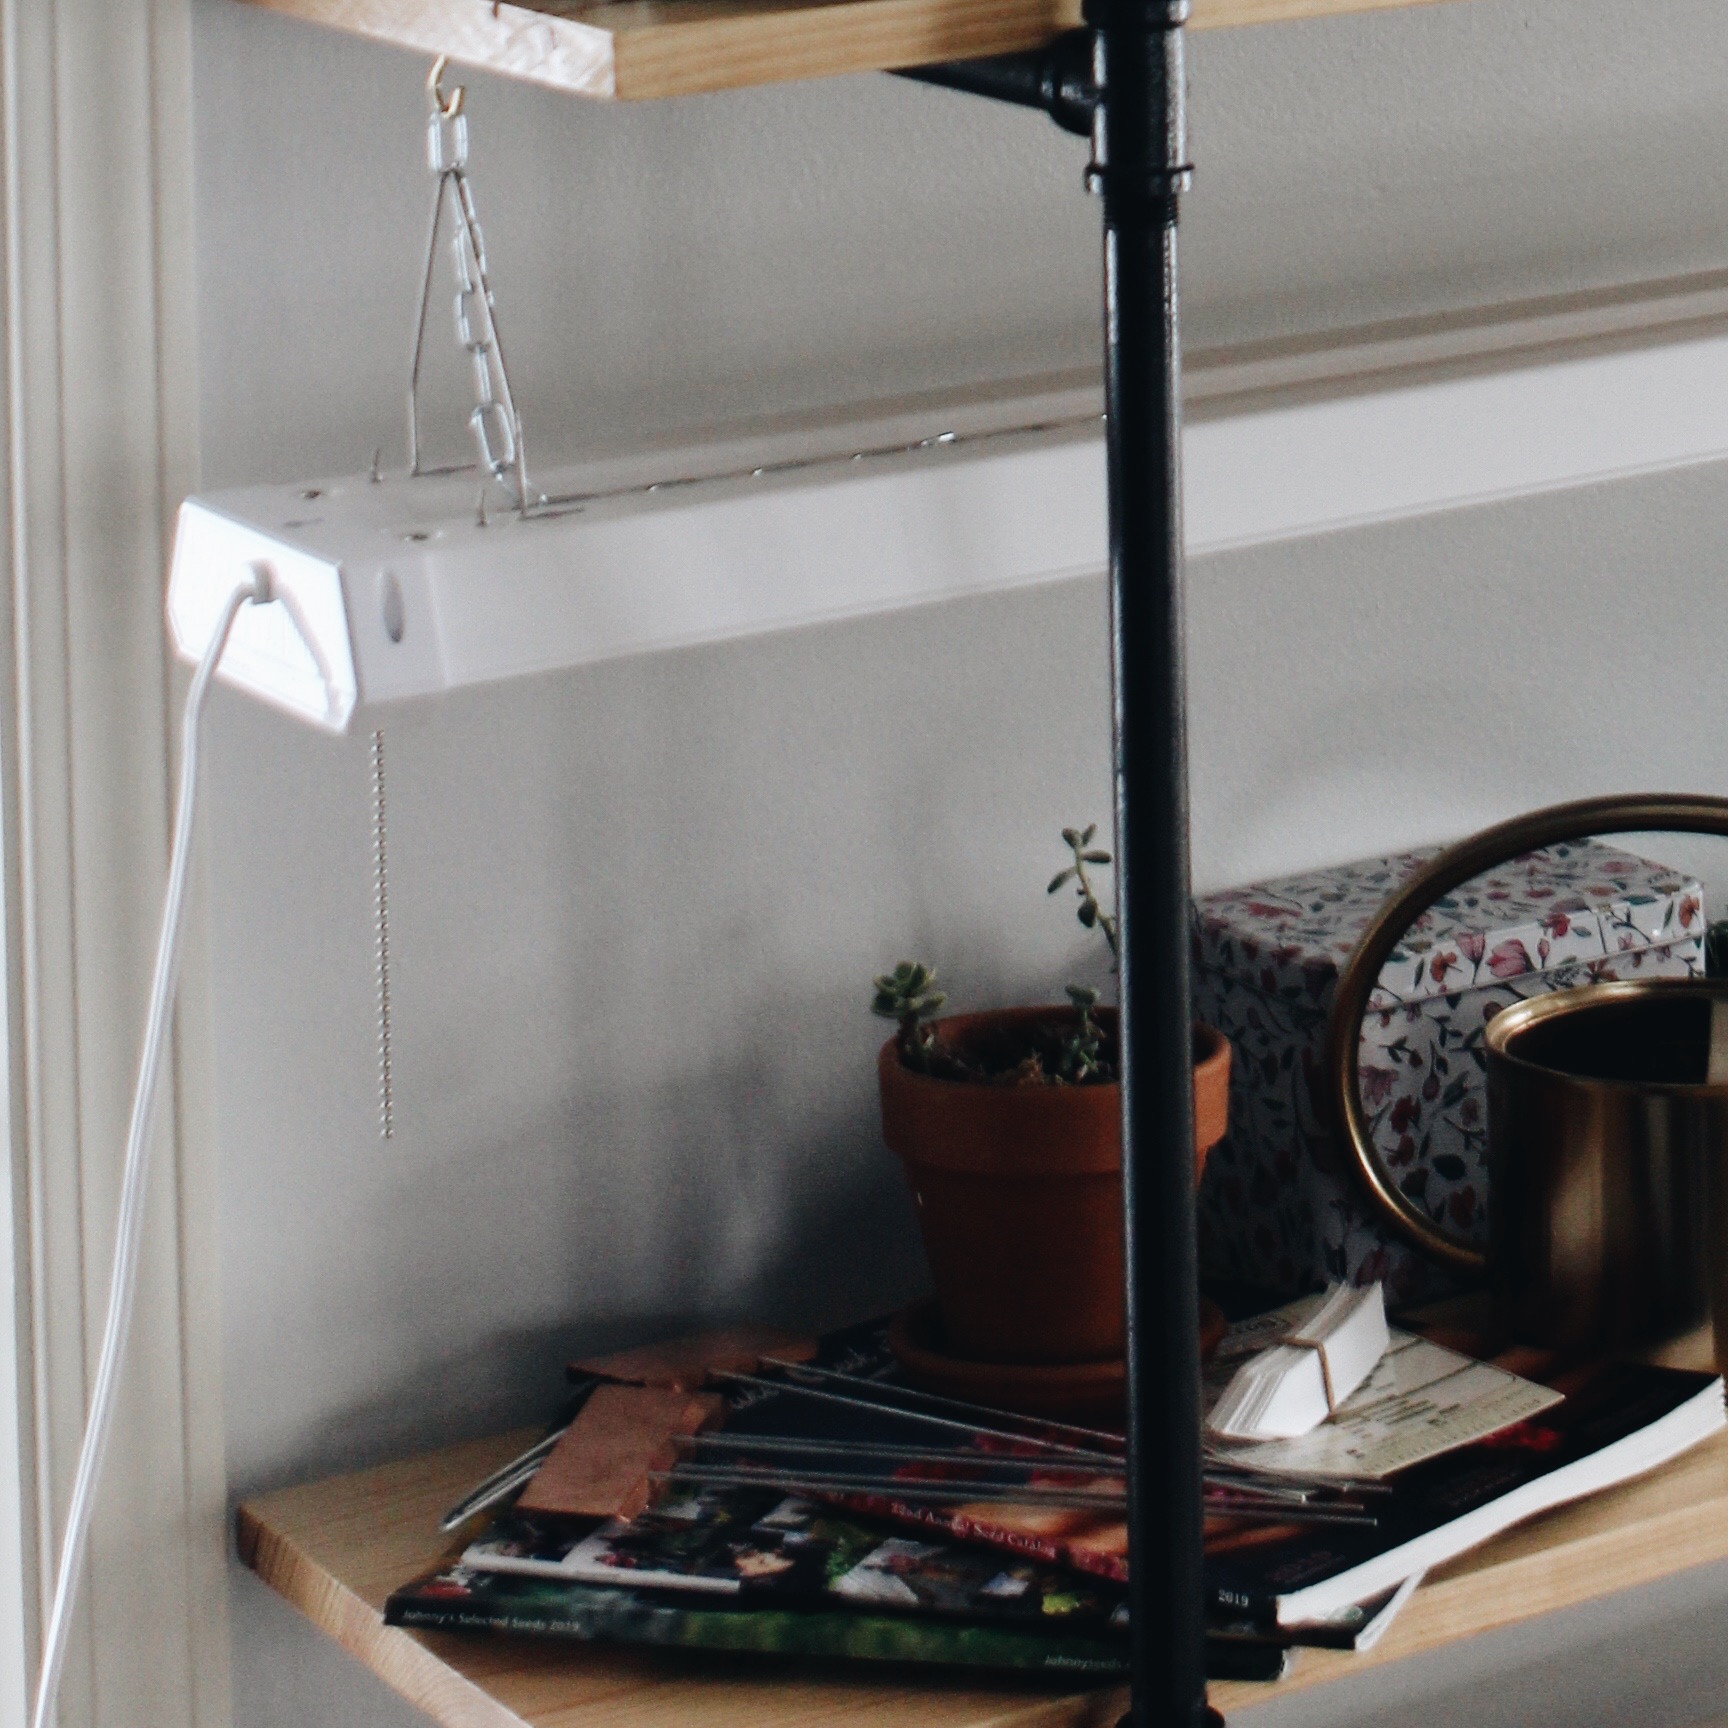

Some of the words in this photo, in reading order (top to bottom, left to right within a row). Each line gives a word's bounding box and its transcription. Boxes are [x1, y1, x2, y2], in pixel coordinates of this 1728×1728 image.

[1218, 1589, 1249, 1608] 2019
[458, 1611, 509, 1628] Selected
[512, 1615, 547, 1632] Seeds
